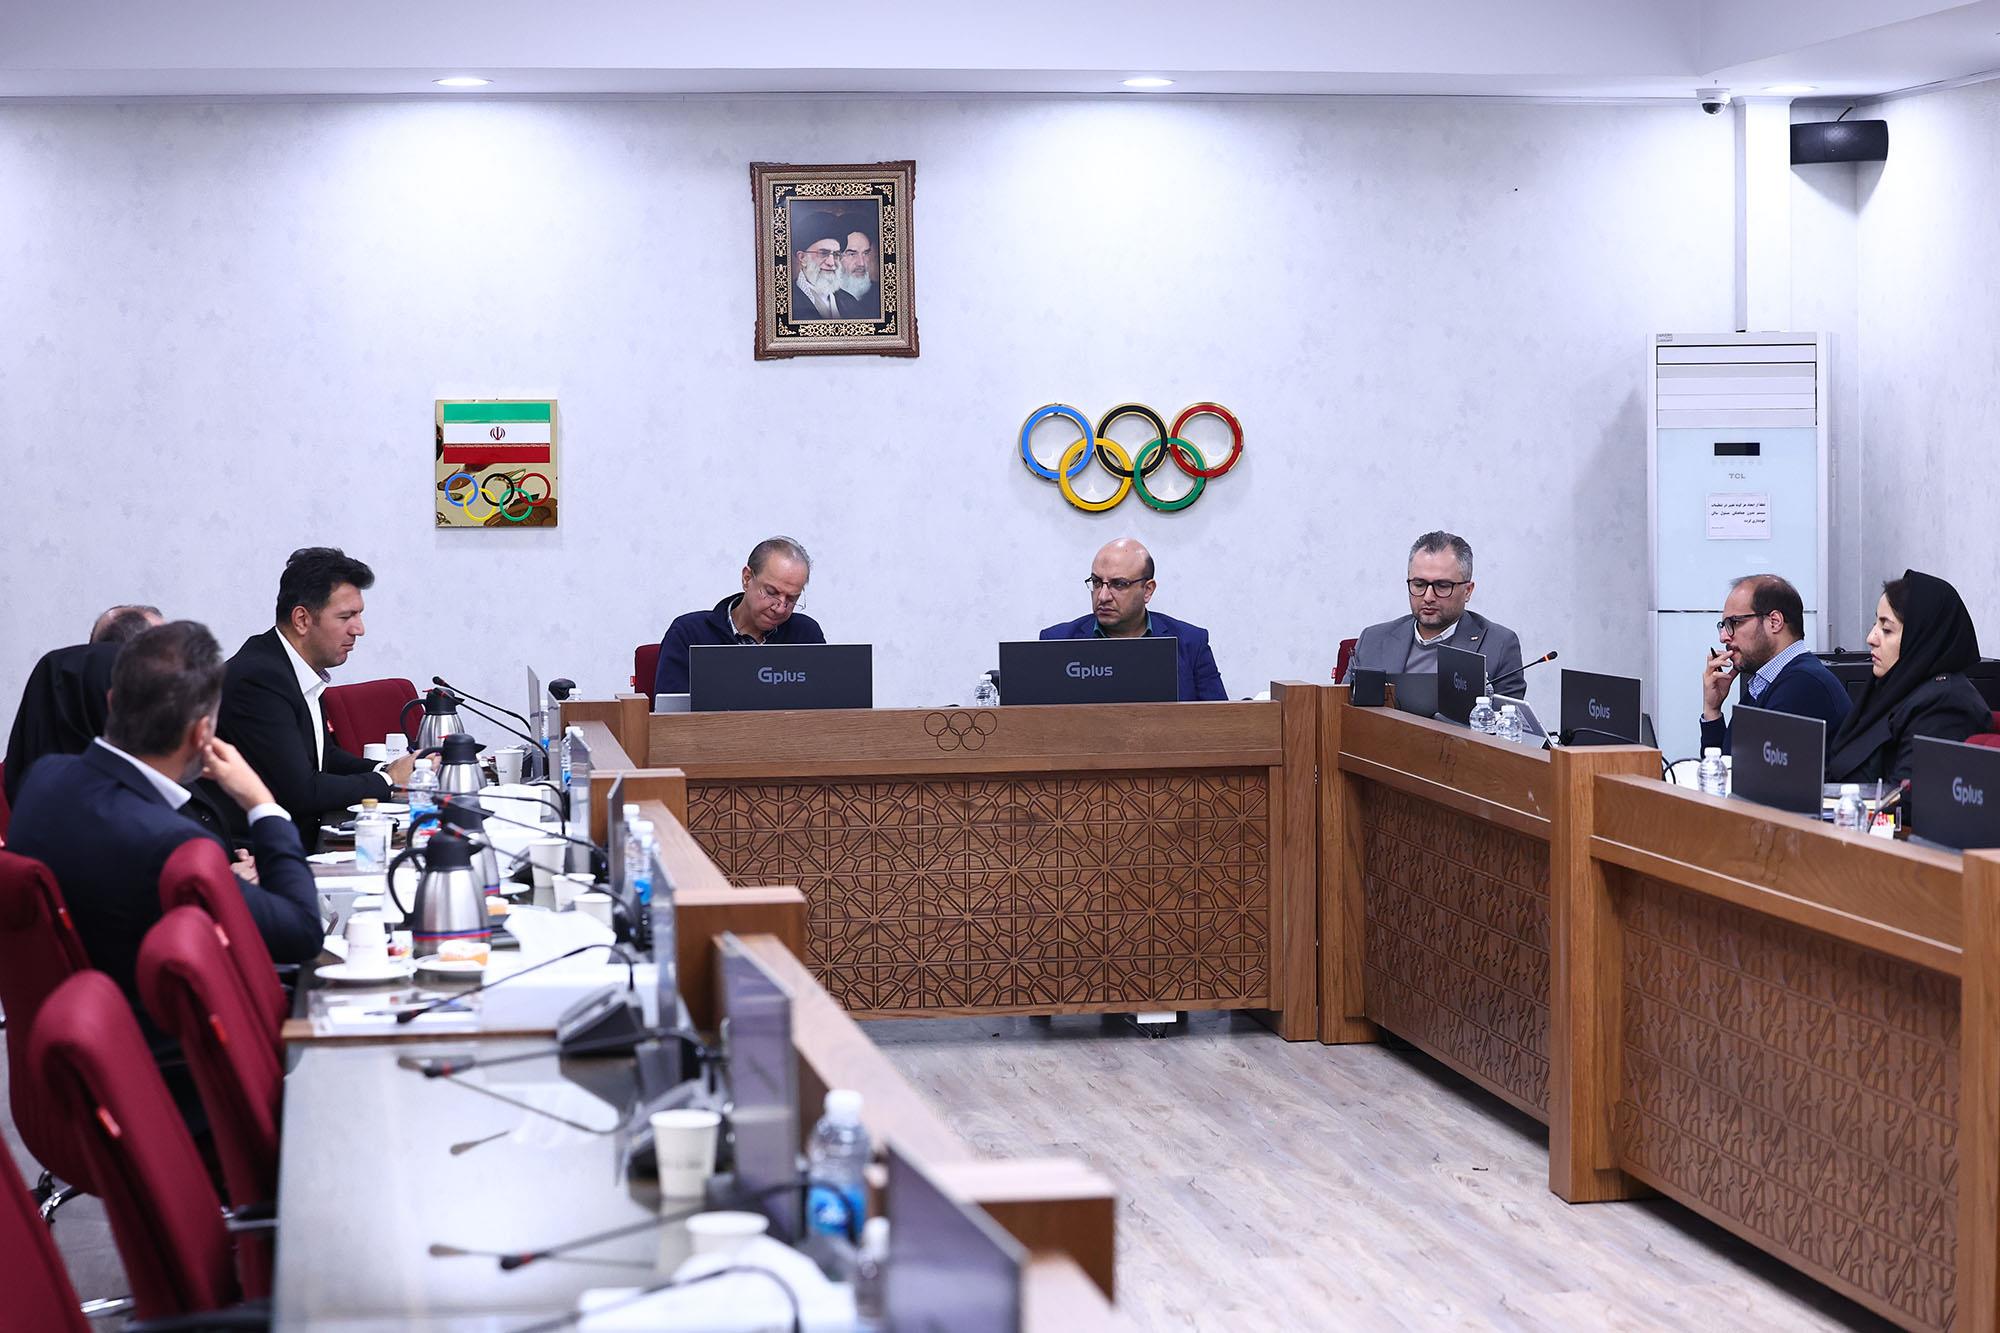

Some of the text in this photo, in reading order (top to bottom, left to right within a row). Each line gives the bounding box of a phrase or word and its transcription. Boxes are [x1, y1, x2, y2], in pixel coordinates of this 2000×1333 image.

[758, 666, 806, 685] Gplus
[1066, 661, 1113, 680] Gplus
[1588, 698, 1610, 720] Gplus
[1763, 741, 1788, 767] Gplus
[1952, 776, 1984, 806] Gplus
